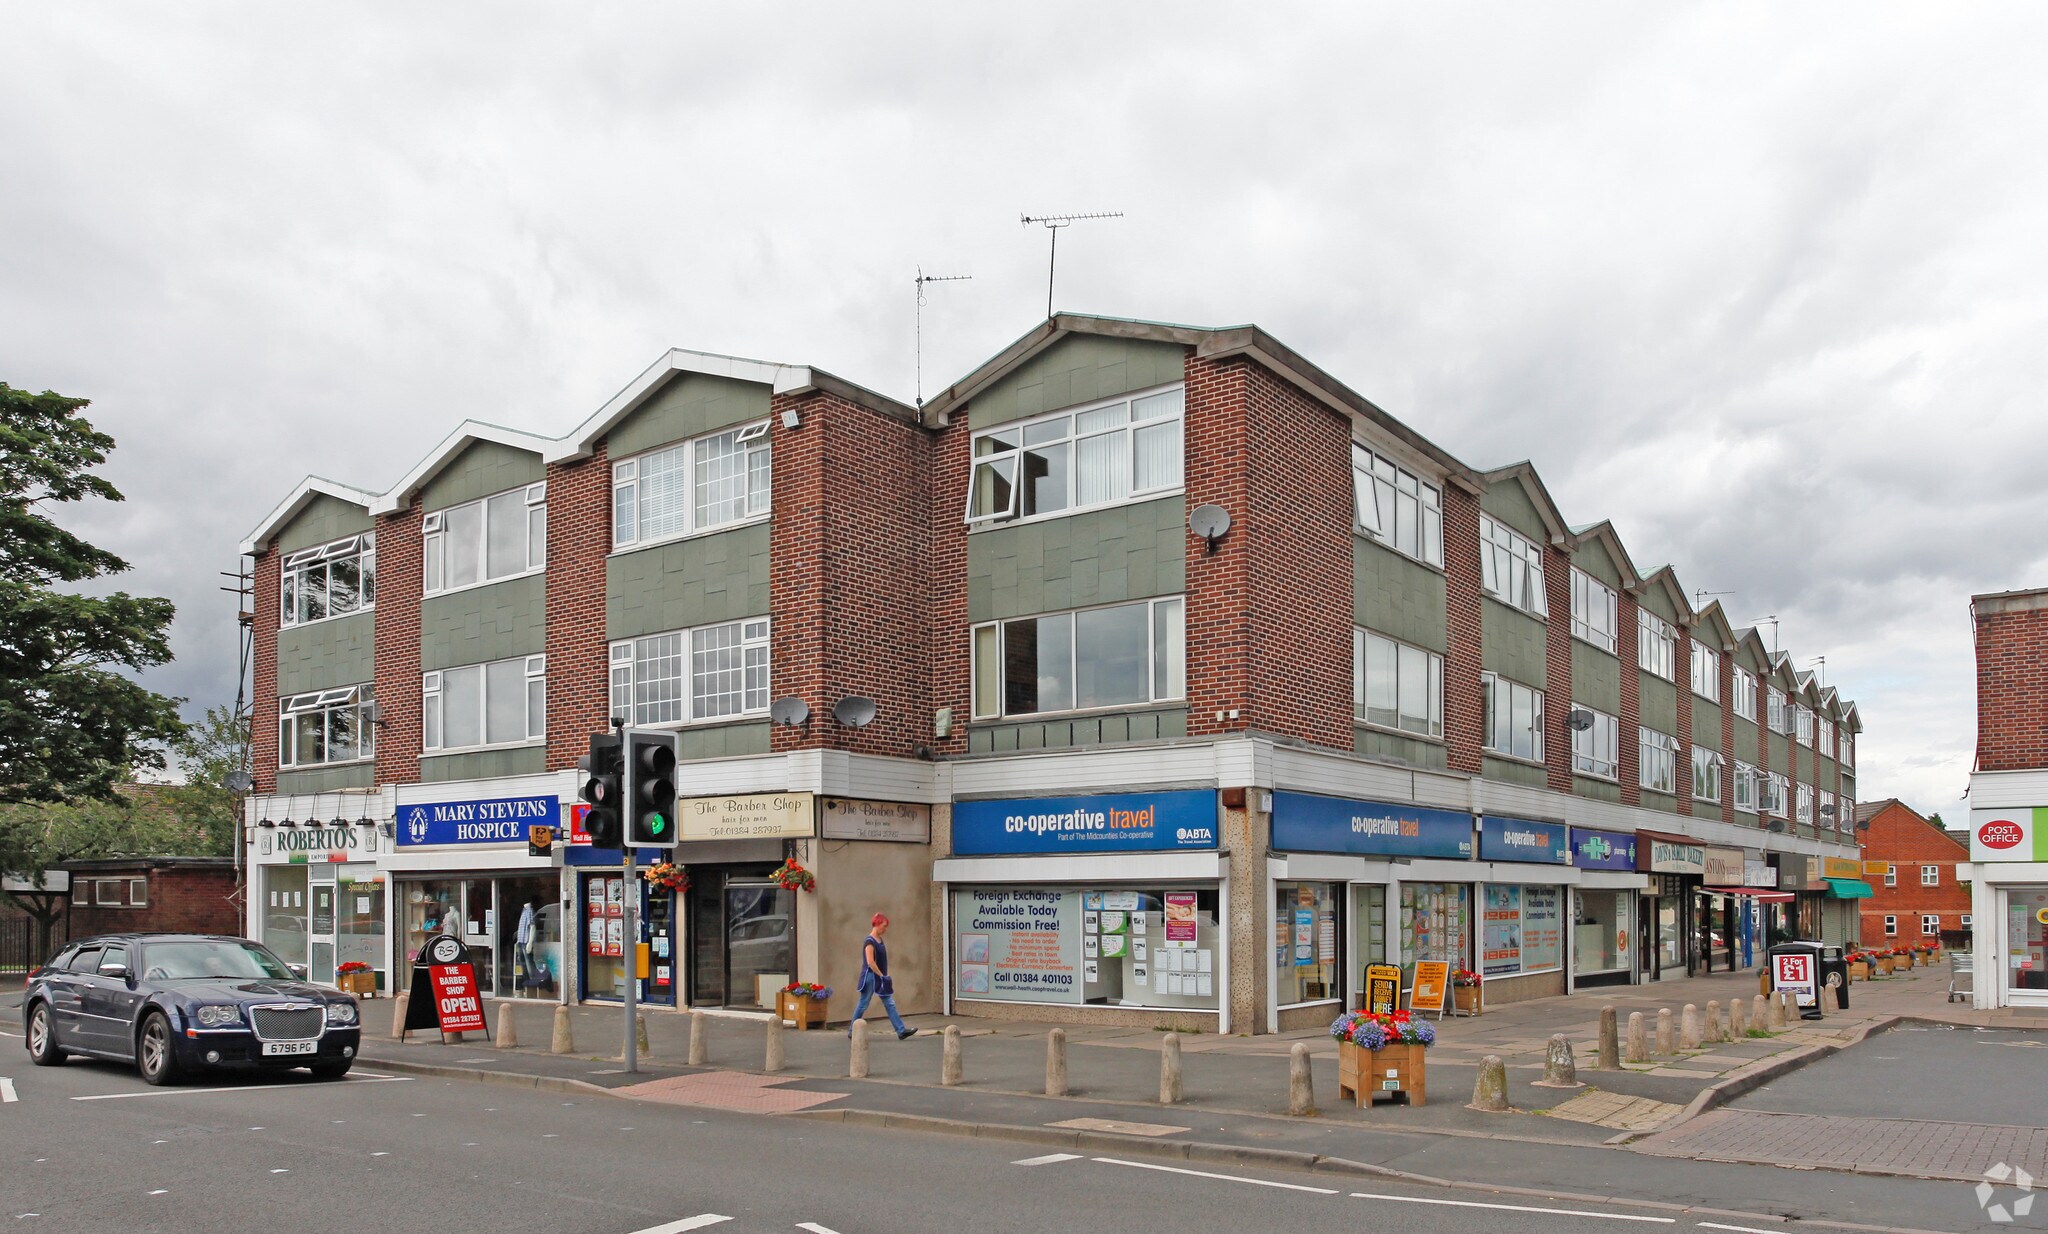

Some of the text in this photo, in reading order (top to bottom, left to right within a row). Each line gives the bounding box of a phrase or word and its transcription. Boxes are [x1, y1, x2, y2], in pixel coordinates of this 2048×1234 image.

[434, 800, 547, 822] MARY STEVENS
[694, 798, 802, 815] The Barber Shop
[837, 801, 917, 821] The Barber Shop
[740, 815, 750, 824] for
[1005, 805, 1154, 836] co-operative travel
[458, 822, 520, 840] HOSPICE
[1352, 816, 1418, 837] co-operative travel
[1988, 826, 2015, 834] POST
[277, 828, 357, 851] ROBERTO'S
[1086, 832, 1118, 840] Midcounties
[1119, 831, 1154, 840] Co-operative
[1186, 829, 1211, 839] ABTA
[1536, 832, 1548, 847] travel
[1982, 834, 2018, 842] OFFICE
[1706, 859, 1725, 874] ASTONS
[348, 882, 364, 892] Special
[974, 890, 1061, 903] Foreign Exchange
[978, 905, 1057, 918] Available Today
[972, 919, 1060, 930] Commission Free!
[1784, 965, 1804, 980] £1
[439, 976, 468, 985] BARBER
[994, 973, 1072, 984] Call 01384 401103
[446, 986, 465, 995] SHOP
[1374, 981, 1392, 989] SEND &
[1374, 988, 1392, 996] RECEIVE
[441, 997, 477, 1013] OPEN
[1373, 1003, 1392, 1014] HERE
[271, 1043, 311, 1053] 6796 PG
